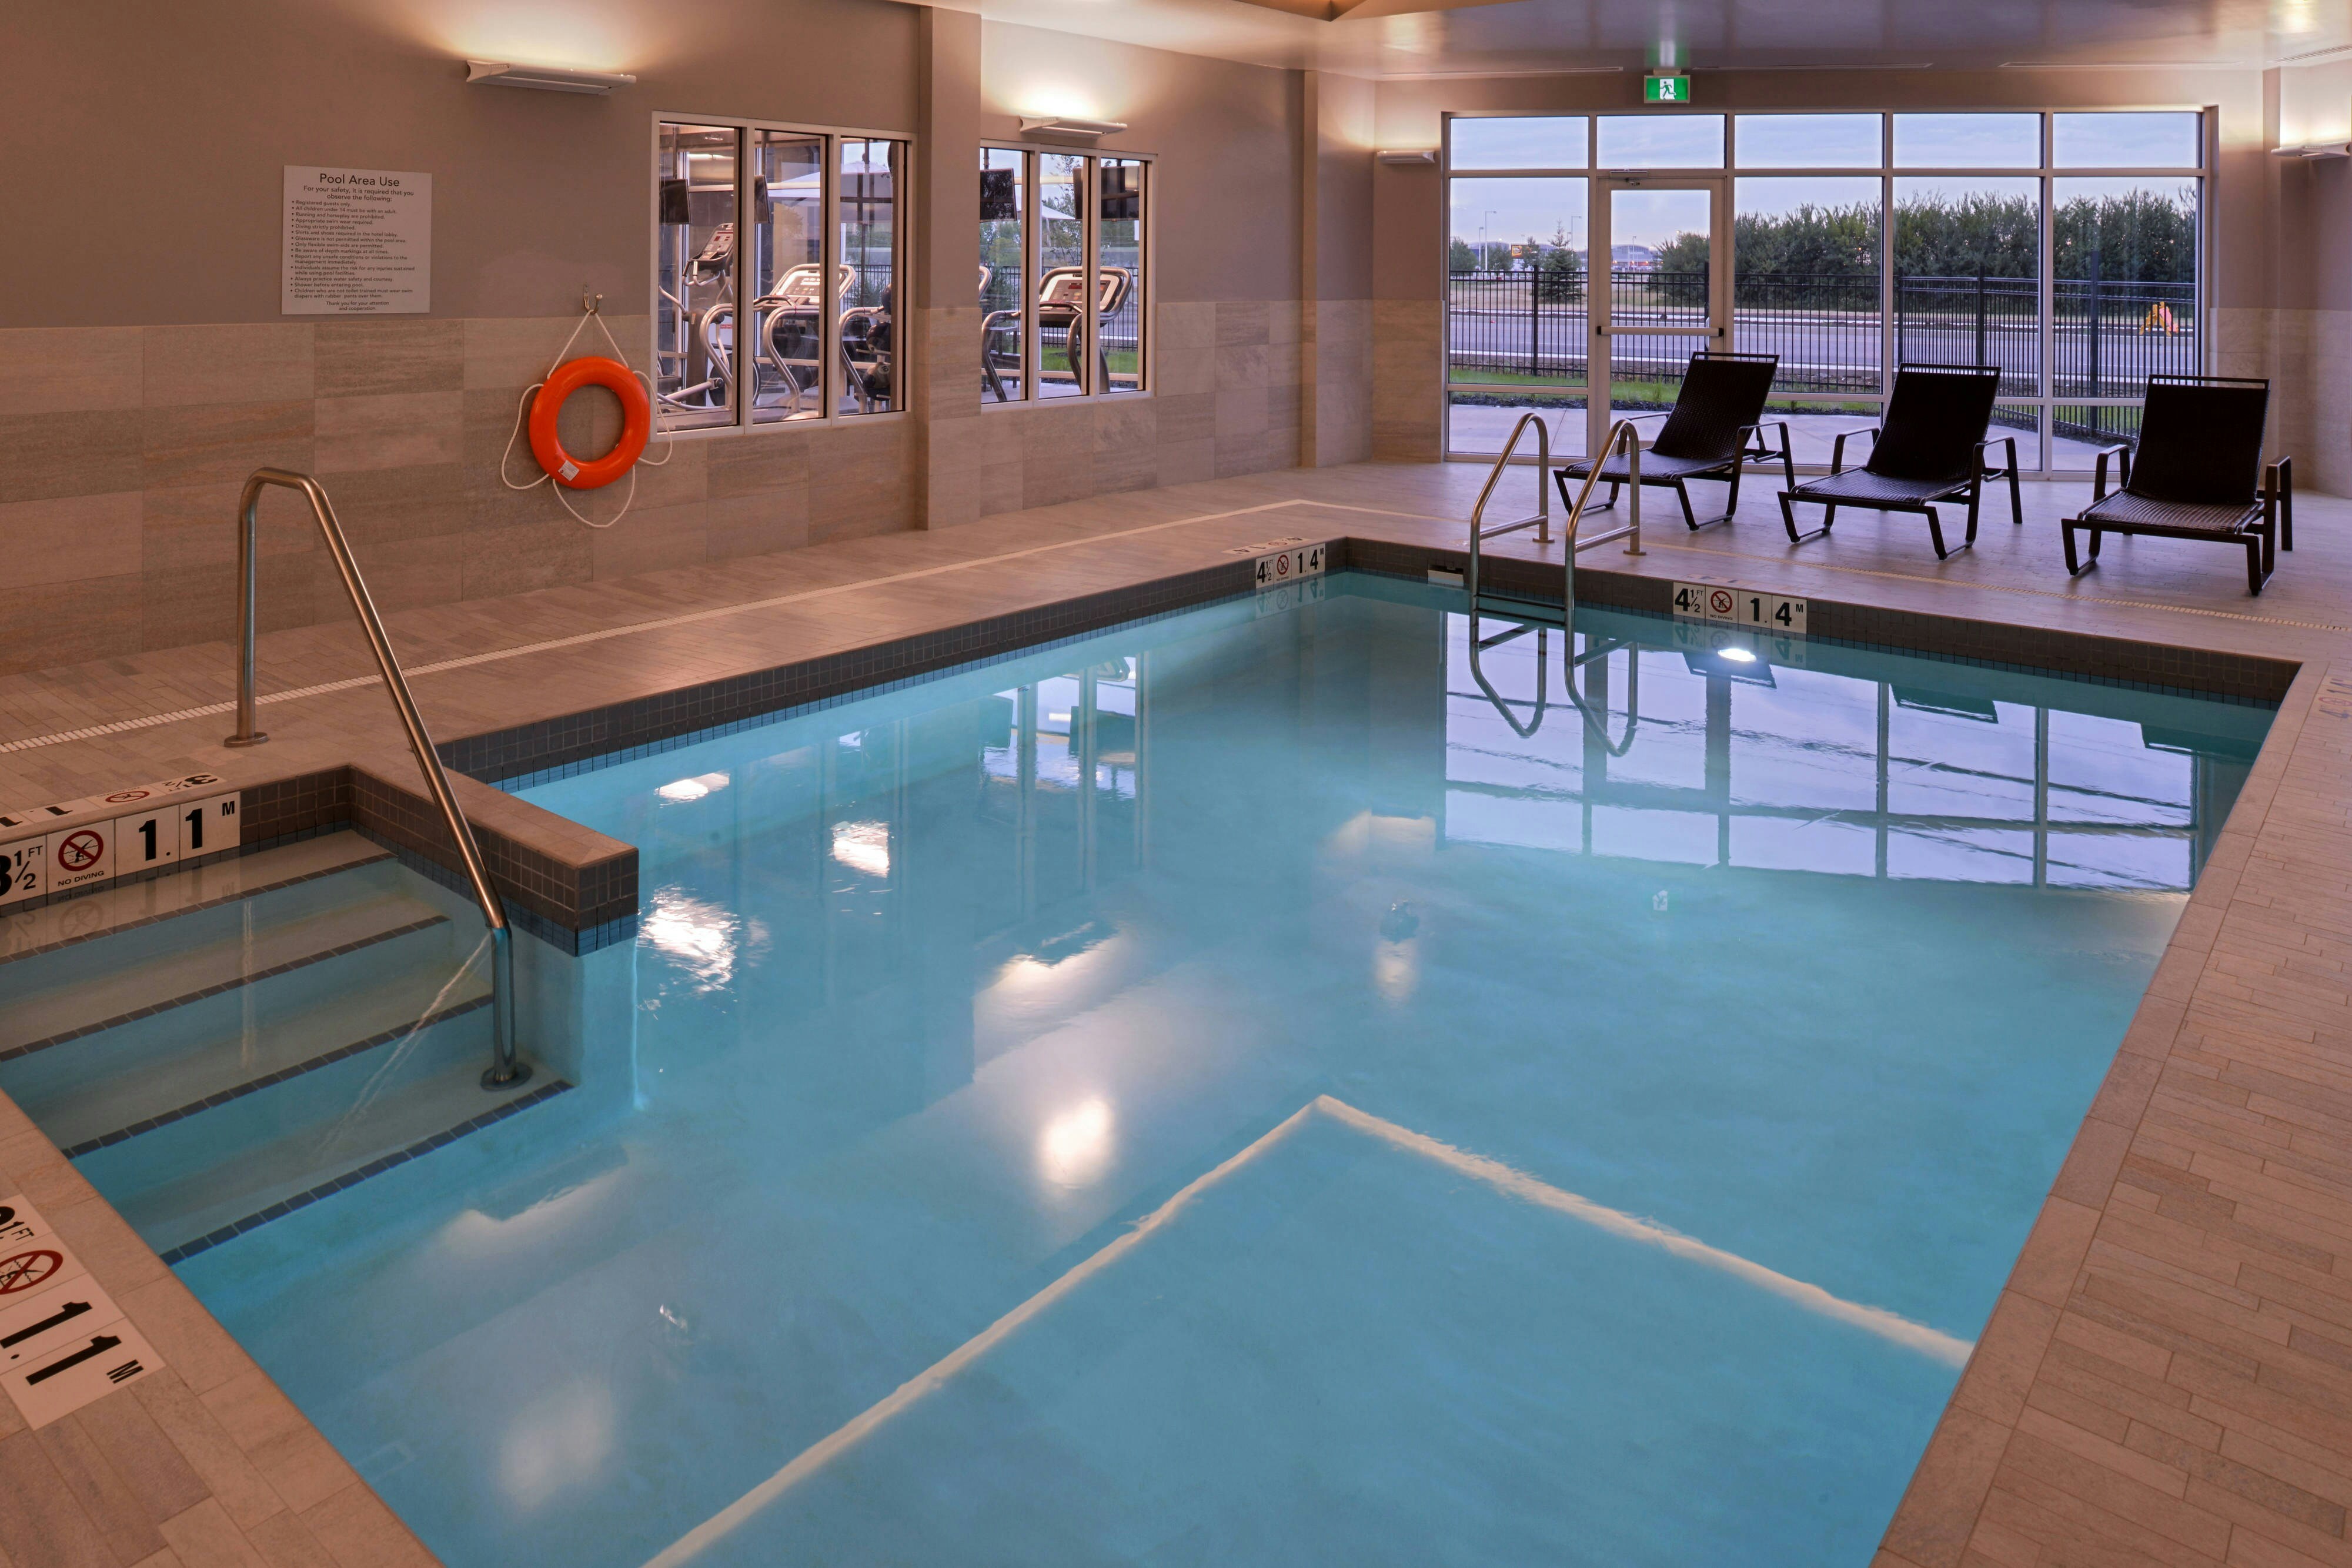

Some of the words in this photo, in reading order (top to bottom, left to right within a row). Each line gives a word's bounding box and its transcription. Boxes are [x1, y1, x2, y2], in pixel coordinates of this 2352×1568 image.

[319, 173, 345, 184] Pool
[349, 175, 375, 185] Area
[379, 176, 399, 186] Use
[330, 186, 350, 195] safety,
[364, 188, 389, 196] required
[363, 195, 392, 203] following:
[1319, 547, 1324, 556] M
[1750, 597, 1792, 627] 1.4
[1795, 603, 1803, 613] M
[138, 808, 203, 861] 1.1
[221, 800, 235, 816] M
[28, 845, 44, 858] FT
[58, 878, 72, 887] NO
[74, 870, 105, 882] DIVING
[106, 1359, 144, 1384] M
